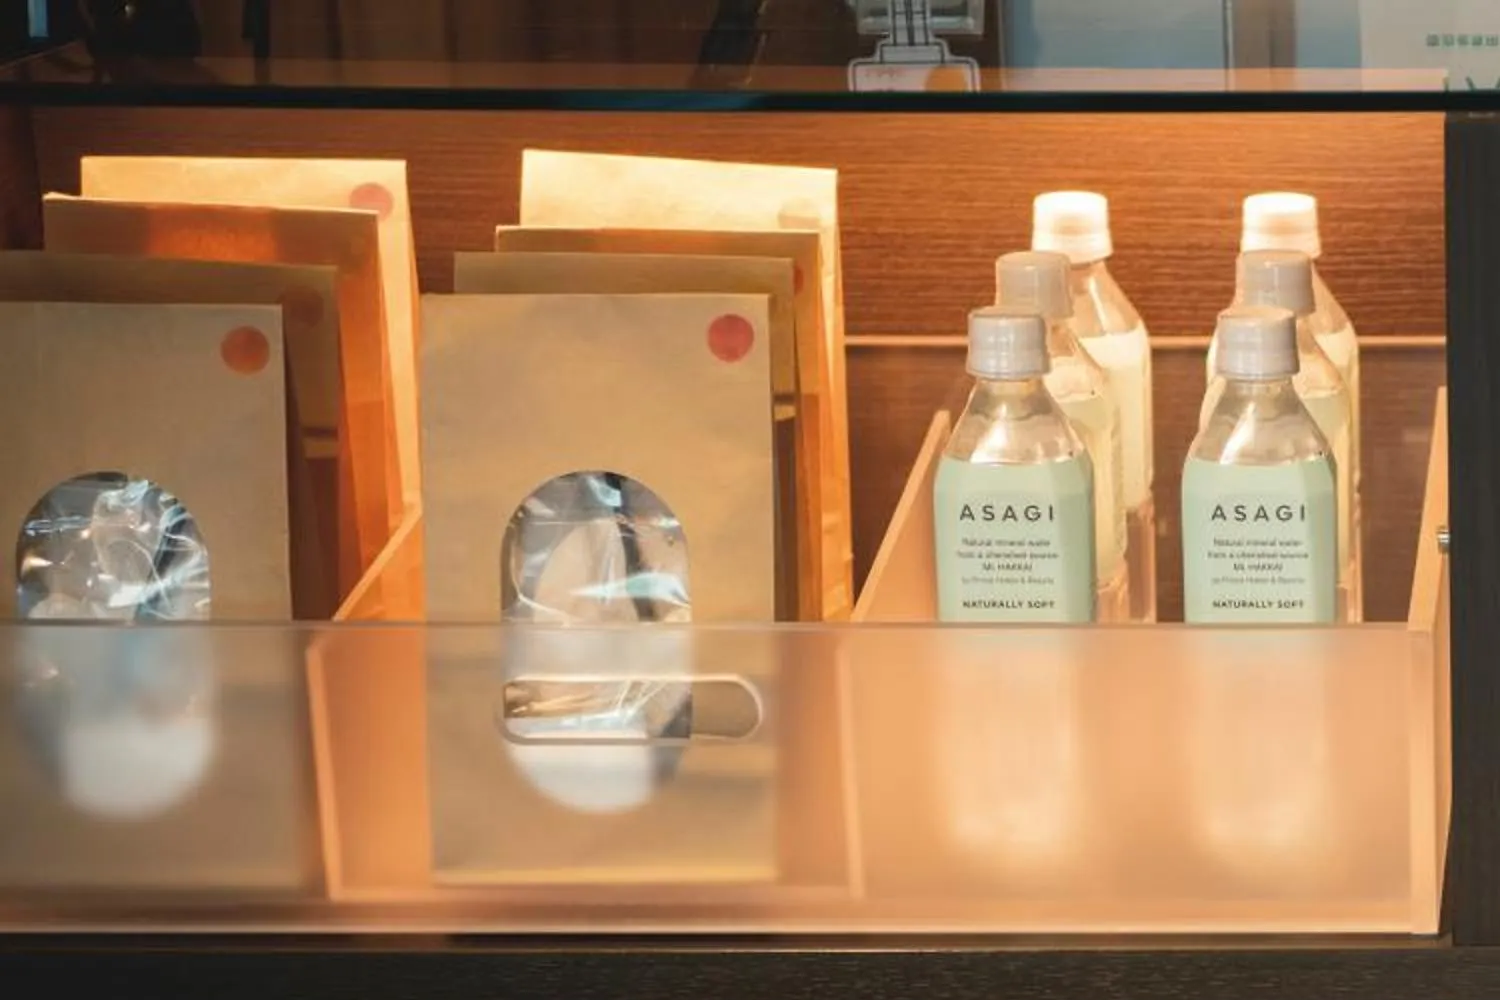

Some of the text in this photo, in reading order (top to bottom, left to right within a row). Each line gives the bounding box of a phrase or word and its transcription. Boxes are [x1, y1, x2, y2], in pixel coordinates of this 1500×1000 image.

[959, 504, 1054, 521] ASAGI
[1211, 504, 1306, 522] ASAGI
[962, 599, 1055, 609] NATURALLY SOFT
[1212, 599, 1304, 609] NATURALLY SOFT
